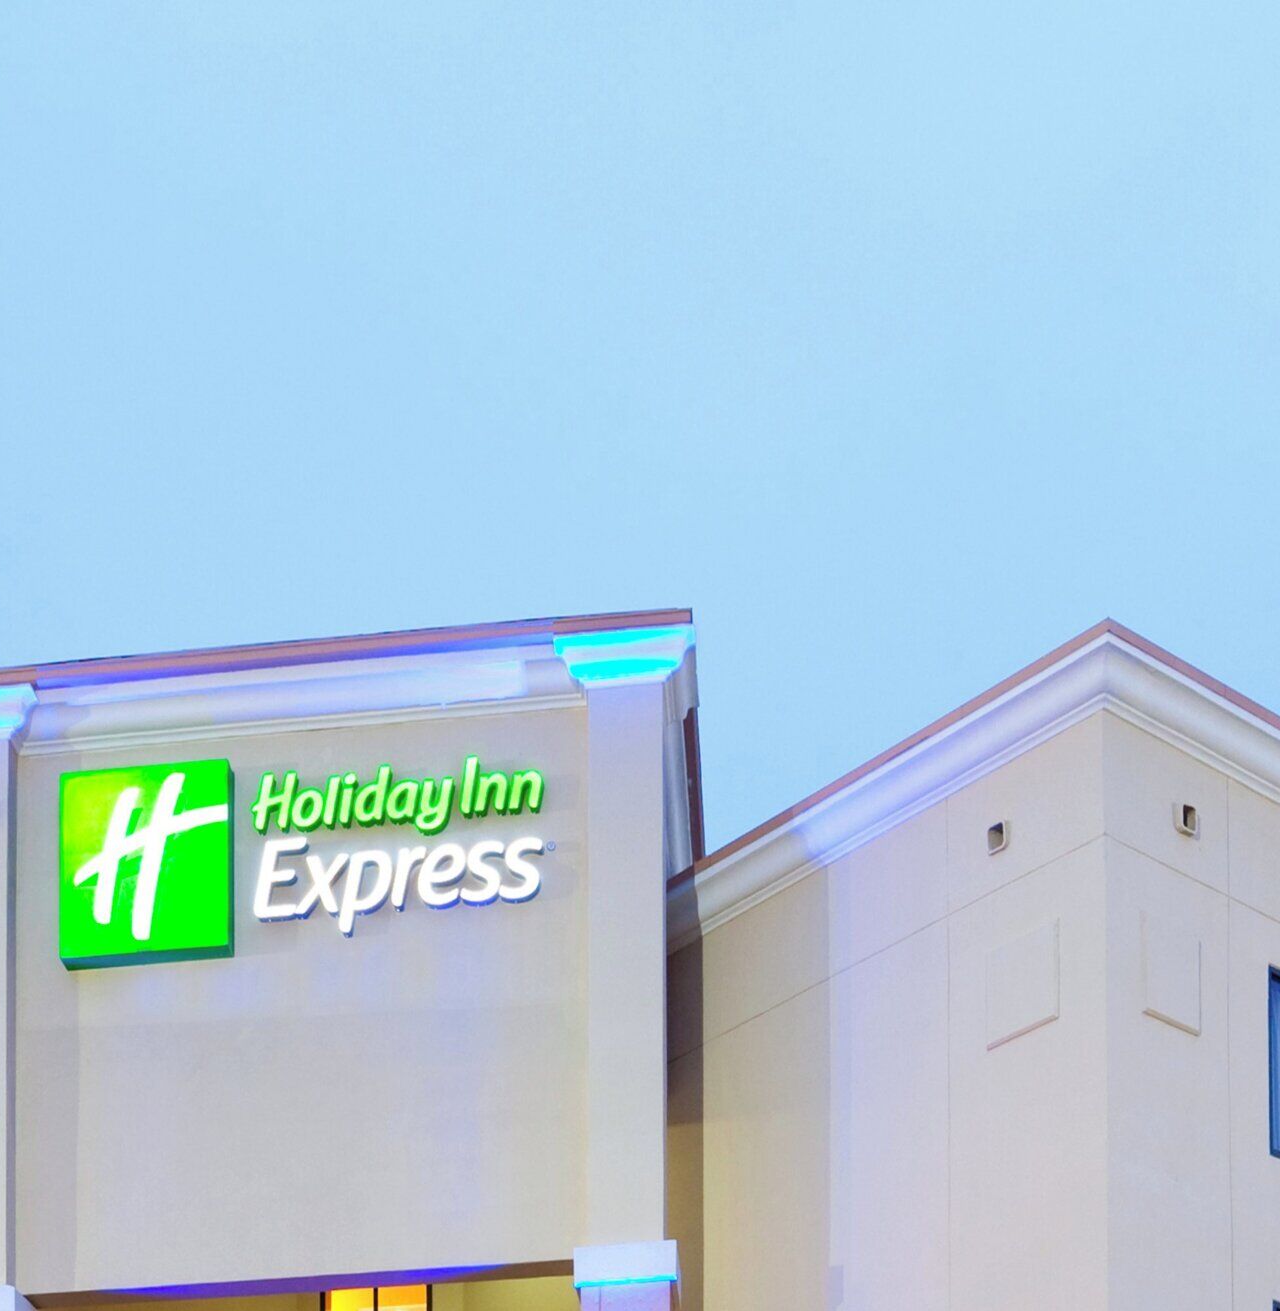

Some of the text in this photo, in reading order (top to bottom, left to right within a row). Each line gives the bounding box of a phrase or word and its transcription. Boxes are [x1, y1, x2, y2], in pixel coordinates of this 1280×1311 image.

[252, 755, 544, 836] Holiday Inn
[253, 837, 545, 937] Express
